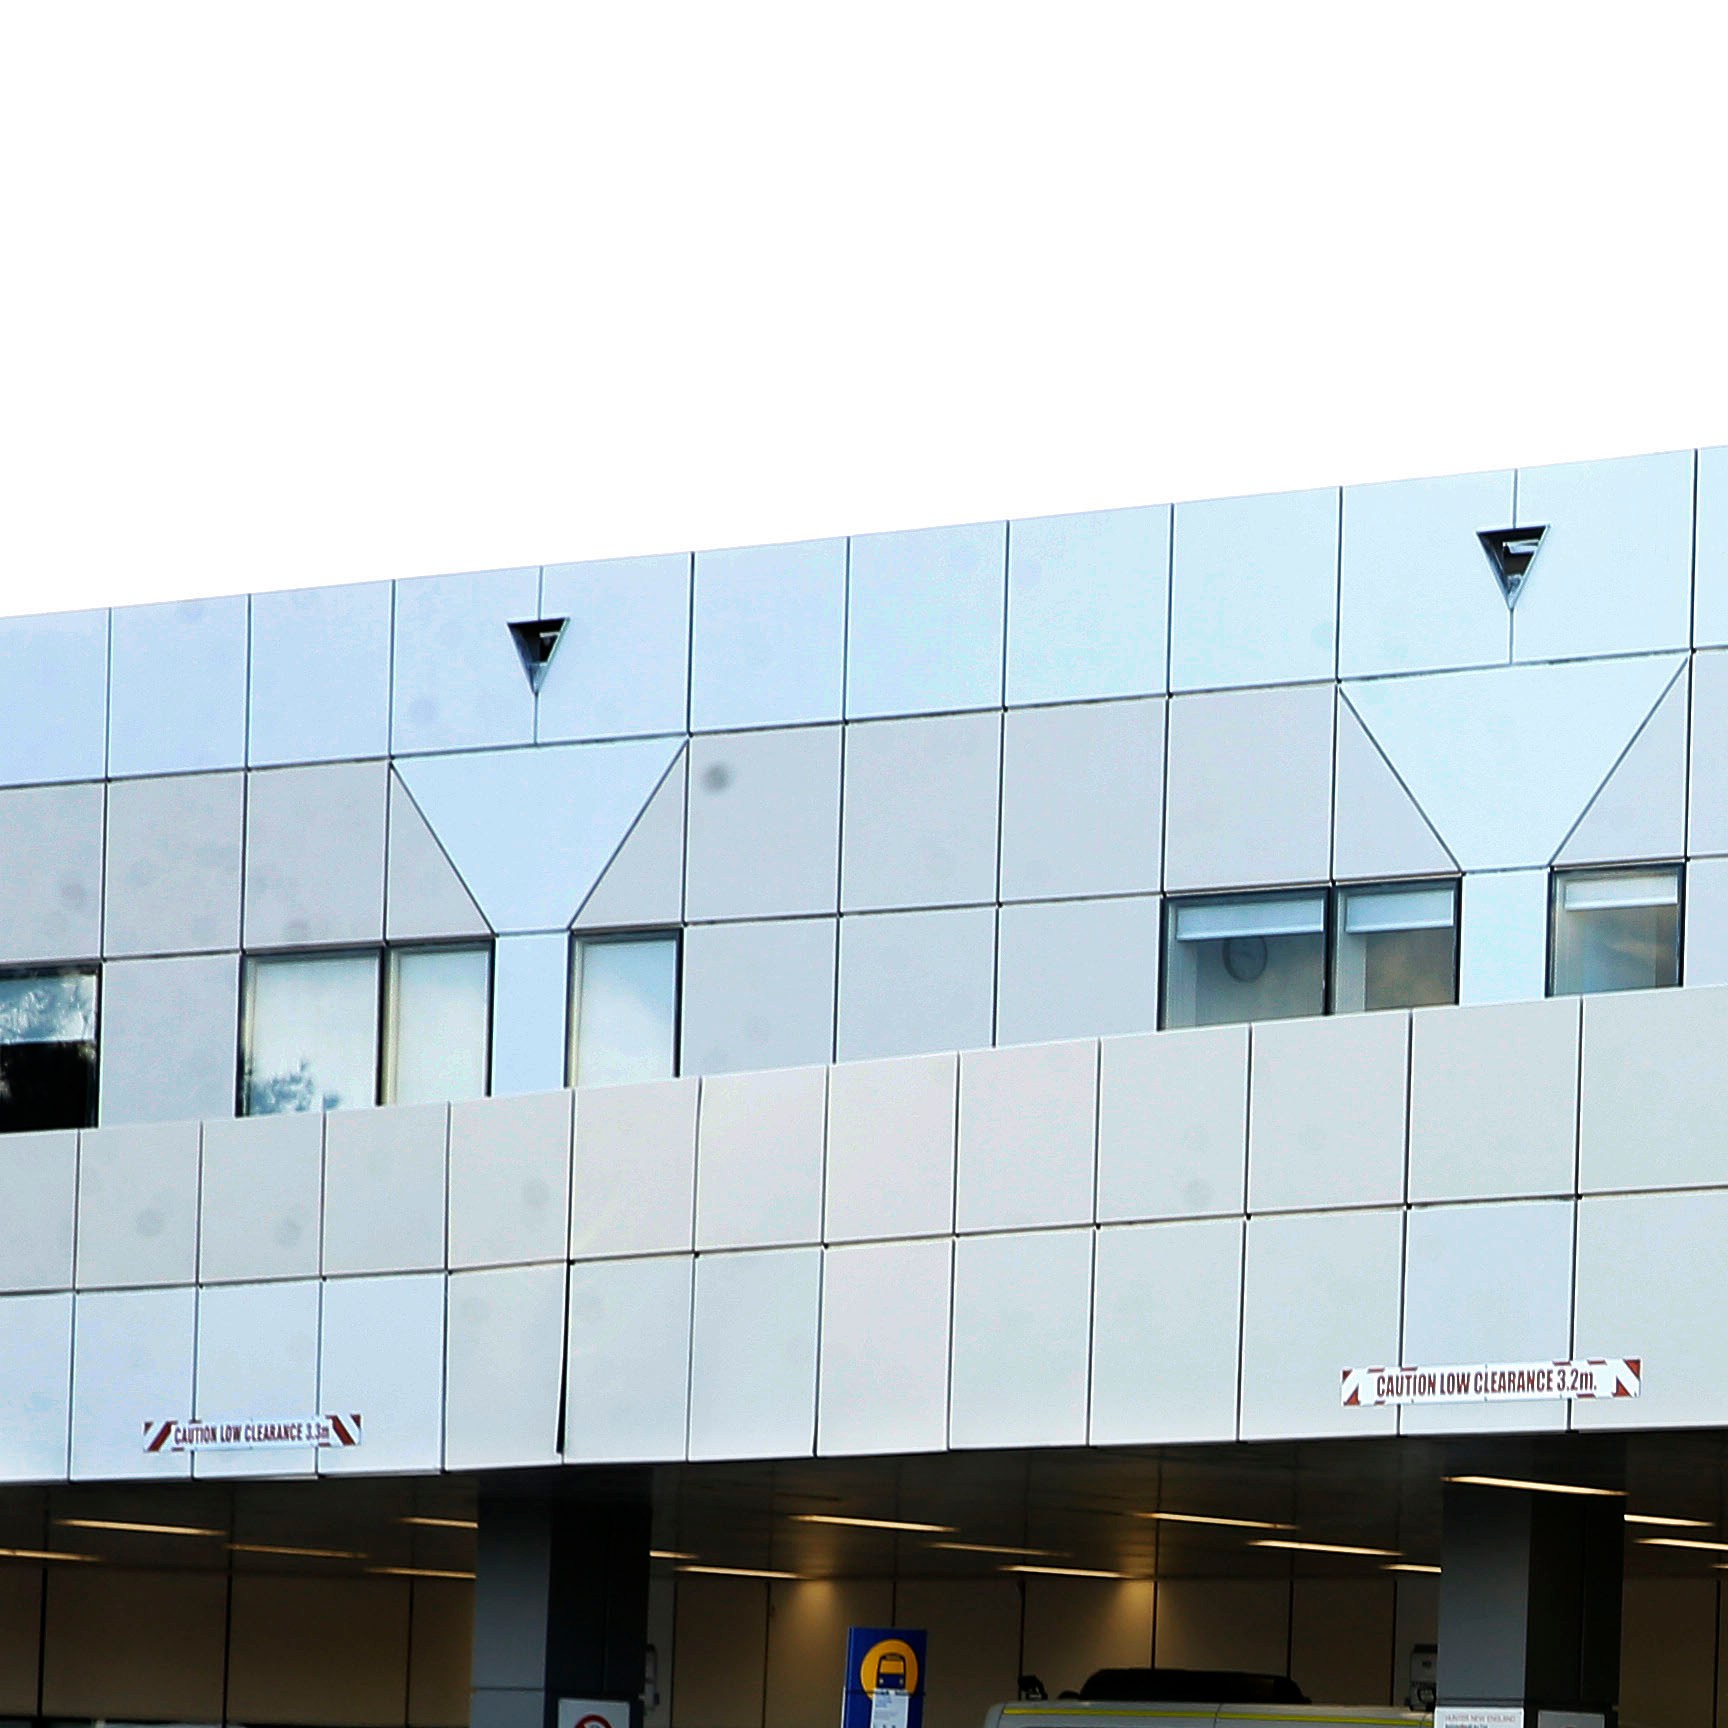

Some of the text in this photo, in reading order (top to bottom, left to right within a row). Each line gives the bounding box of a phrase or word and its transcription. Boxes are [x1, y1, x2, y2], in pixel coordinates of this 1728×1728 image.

[1376, 1372, 1436, 1397] CAUTION
[1439, 1371, 1471, 1396] LOW
[1474, 1369, 1553, 1394] CLEARANCE
[174, 1425, 217, 1445] CAUTION
[220, 1424, 242, 1443] LOW
[245, 1422, 302, 1443] CLEARANCE
